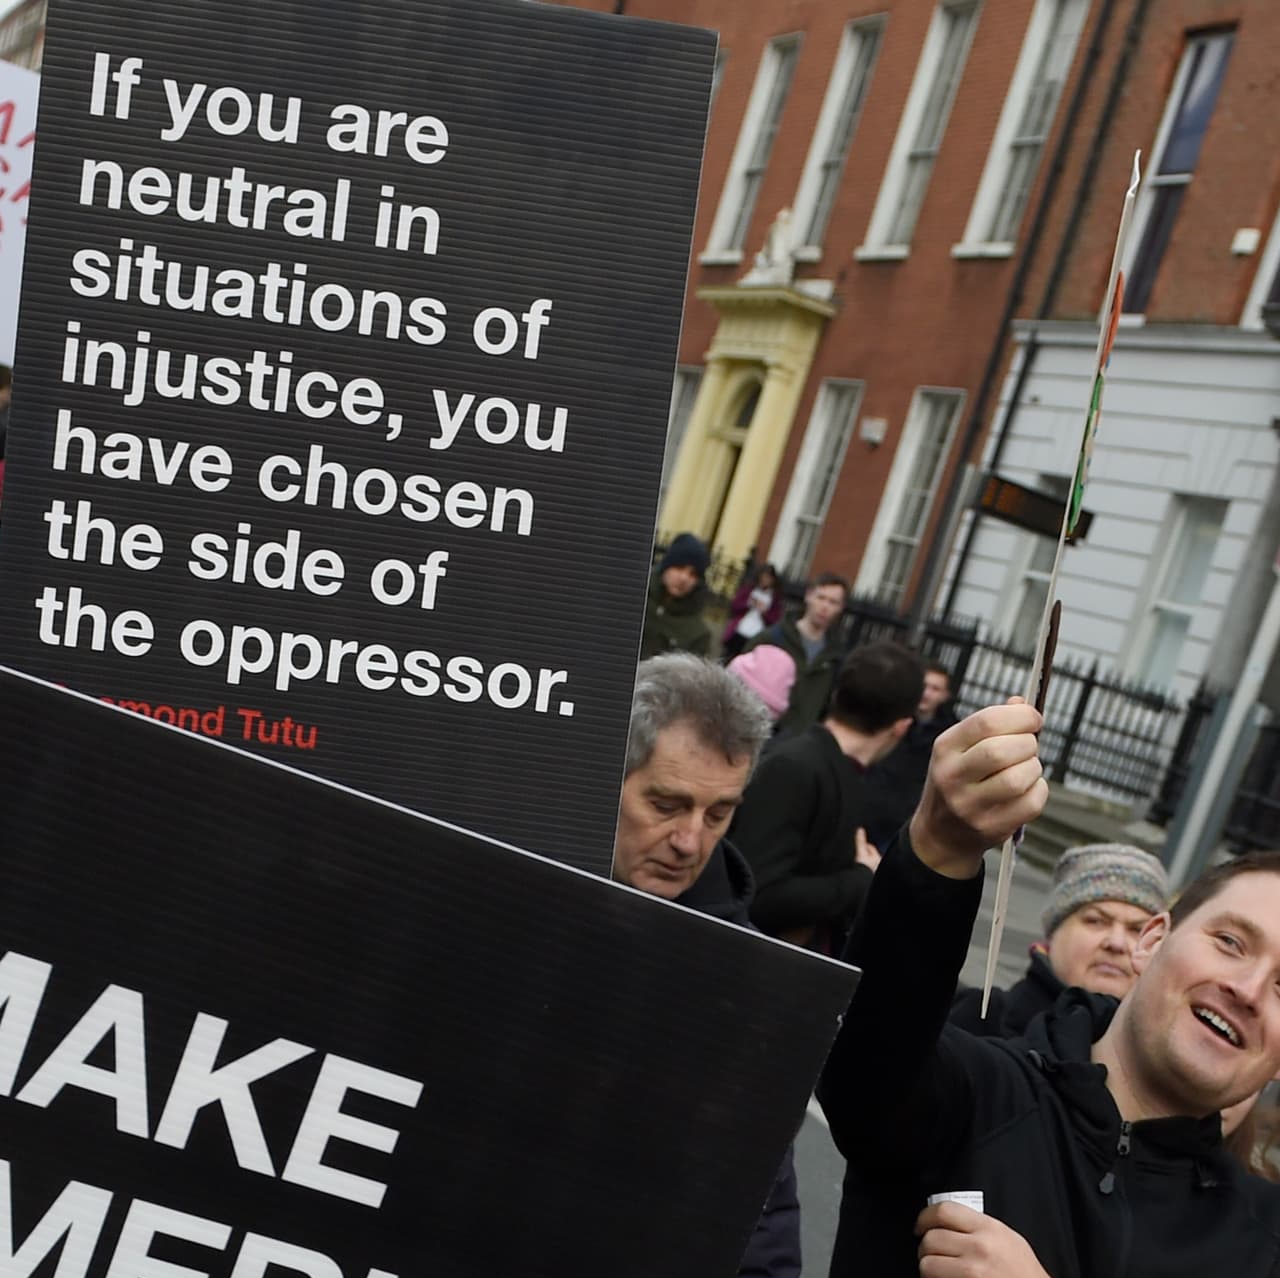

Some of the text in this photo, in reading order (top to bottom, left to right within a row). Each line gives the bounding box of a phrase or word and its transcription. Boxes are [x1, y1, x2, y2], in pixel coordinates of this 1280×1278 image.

[89, 52, 449, 164] If you are
[79, 159, 440, 255] neutral in
[69, 237, 553, 360] situations of
[62, 320, 569, 453] injustice, you
[53, 408, 534, 536] have chosen
[44, 500, 449, 610] the side of
[35, 586, 574, 717] the oppressor.
[237, 707, 319, 750] Tutu
